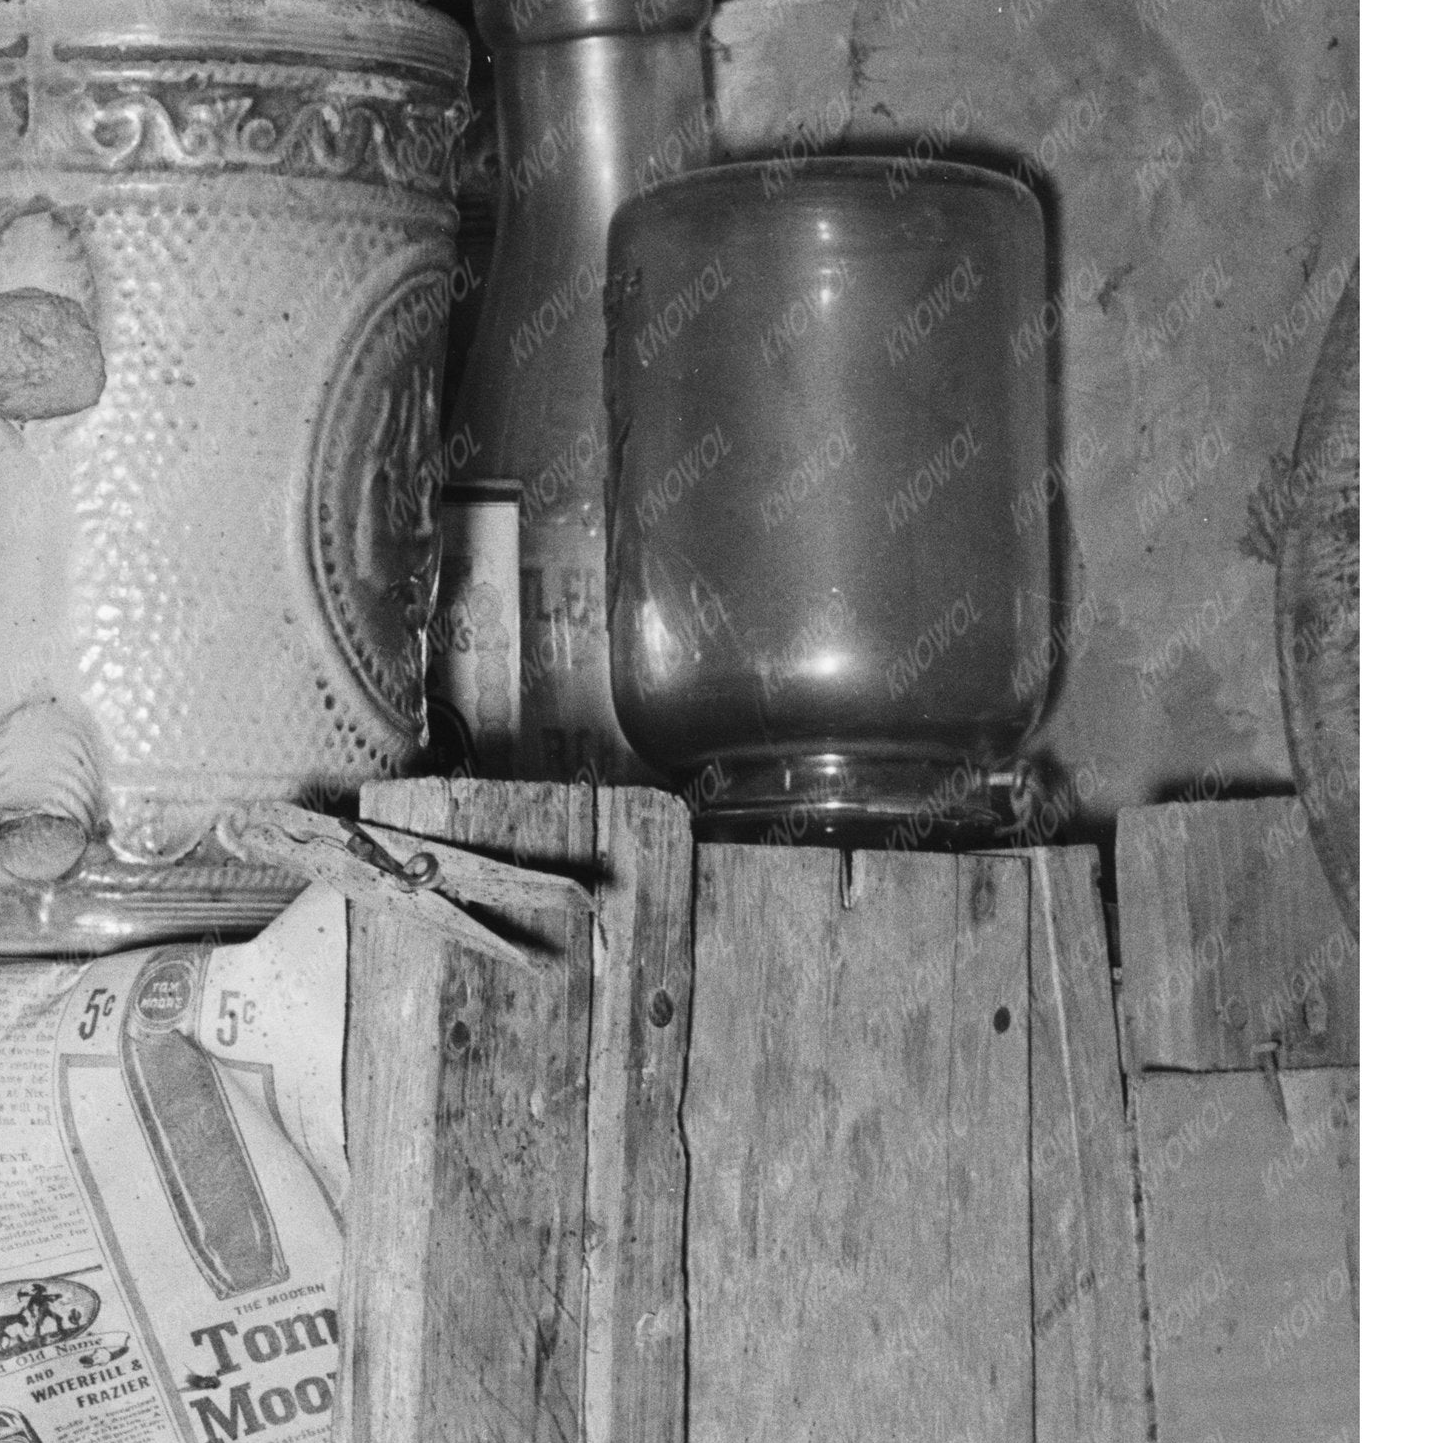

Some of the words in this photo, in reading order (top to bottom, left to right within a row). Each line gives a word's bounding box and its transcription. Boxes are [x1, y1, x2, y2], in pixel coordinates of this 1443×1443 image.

[234, 1300, 263, 1316] THE
[267, 1283, 327, 1306] MODERN
[16, 1350, 46, 1368] Old
[54, 1336, 104, 1357] Name
[190, 1308, 339, 1377] Tom
[25, 1368, 55, 1385] AND
[31, 1365, 126, 1404] WATERFILL
[130, 1359, 144, 1372] &
[76, 1375, 151, 1408] FRAZIER
